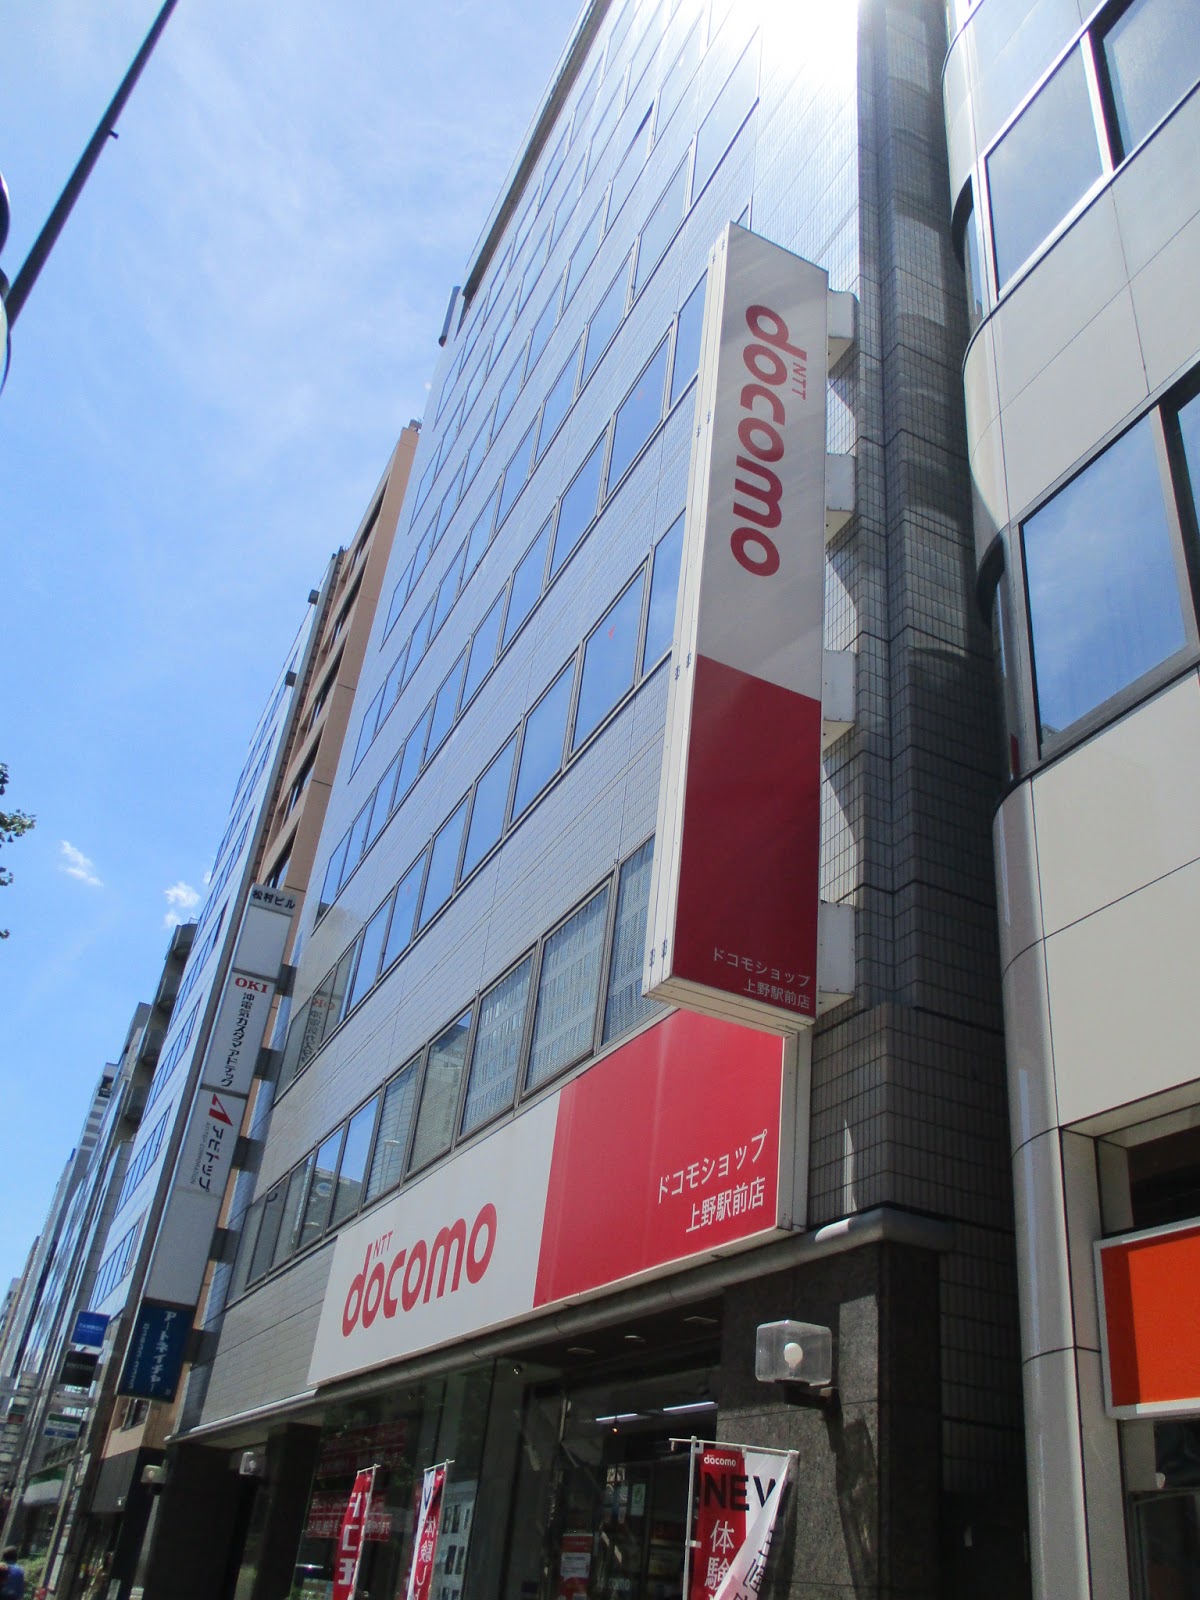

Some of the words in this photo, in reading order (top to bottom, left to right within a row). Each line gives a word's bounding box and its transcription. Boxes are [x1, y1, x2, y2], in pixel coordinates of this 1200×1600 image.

[791, 362, 808, 400] NTT
[730, 304, 807, 577] docomo
[252, 889, 296, 910] 松村ビル
[235, 977, 269, 994] OKI
[713, 947, 811, 987] ドコモショップ
[743, 978, 810, 1009] 上野駅前店
[220, 992, 255, 1087] 沖電気カスタマアドテック
[198, 1125, 224, 1193] アビトップ
[658, 1128, 768, 1204] ドコモショップ
[686, 1177, 766, 1233] 上野駅前店
[373, 1230, 394, 1258] NTT
[342, 1203, 498, 1337] docomo
[703, 1455, 737, 1467] docomo
